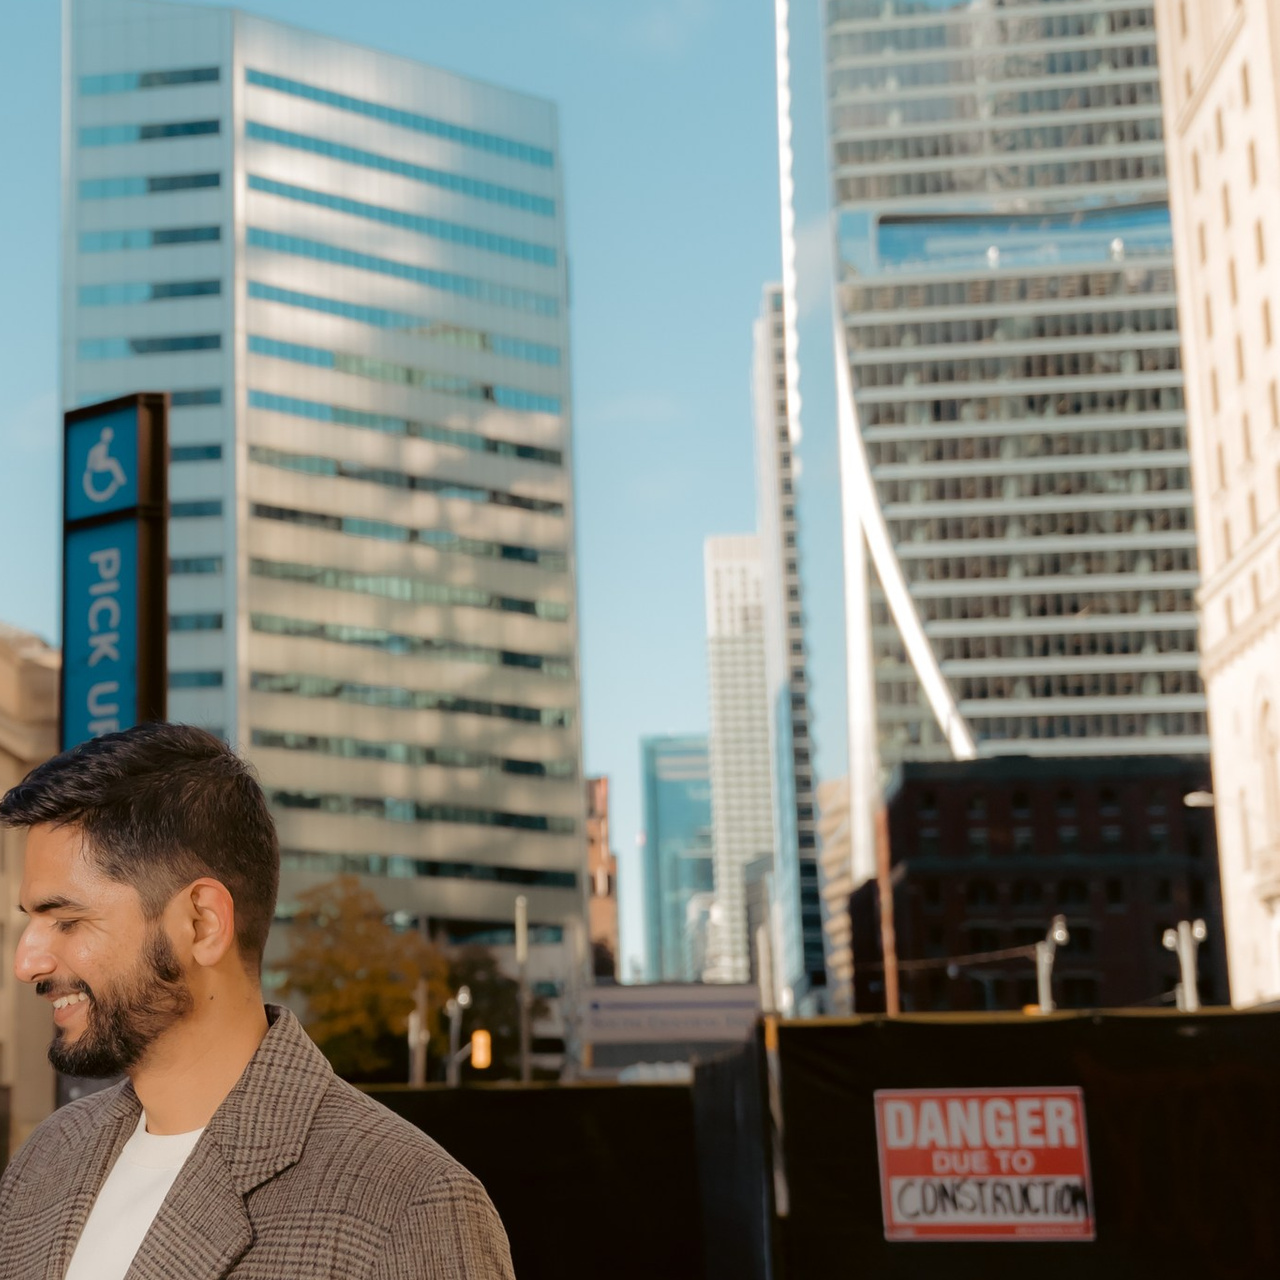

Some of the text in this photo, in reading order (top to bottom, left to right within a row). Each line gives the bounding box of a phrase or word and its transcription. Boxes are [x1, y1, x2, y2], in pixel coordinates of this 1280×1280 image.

[88, 547, 121, 668] PICK
[884, 1097, 1077, 1149] DANGER
[933, 1150, 1035, 1173] DUE TO
